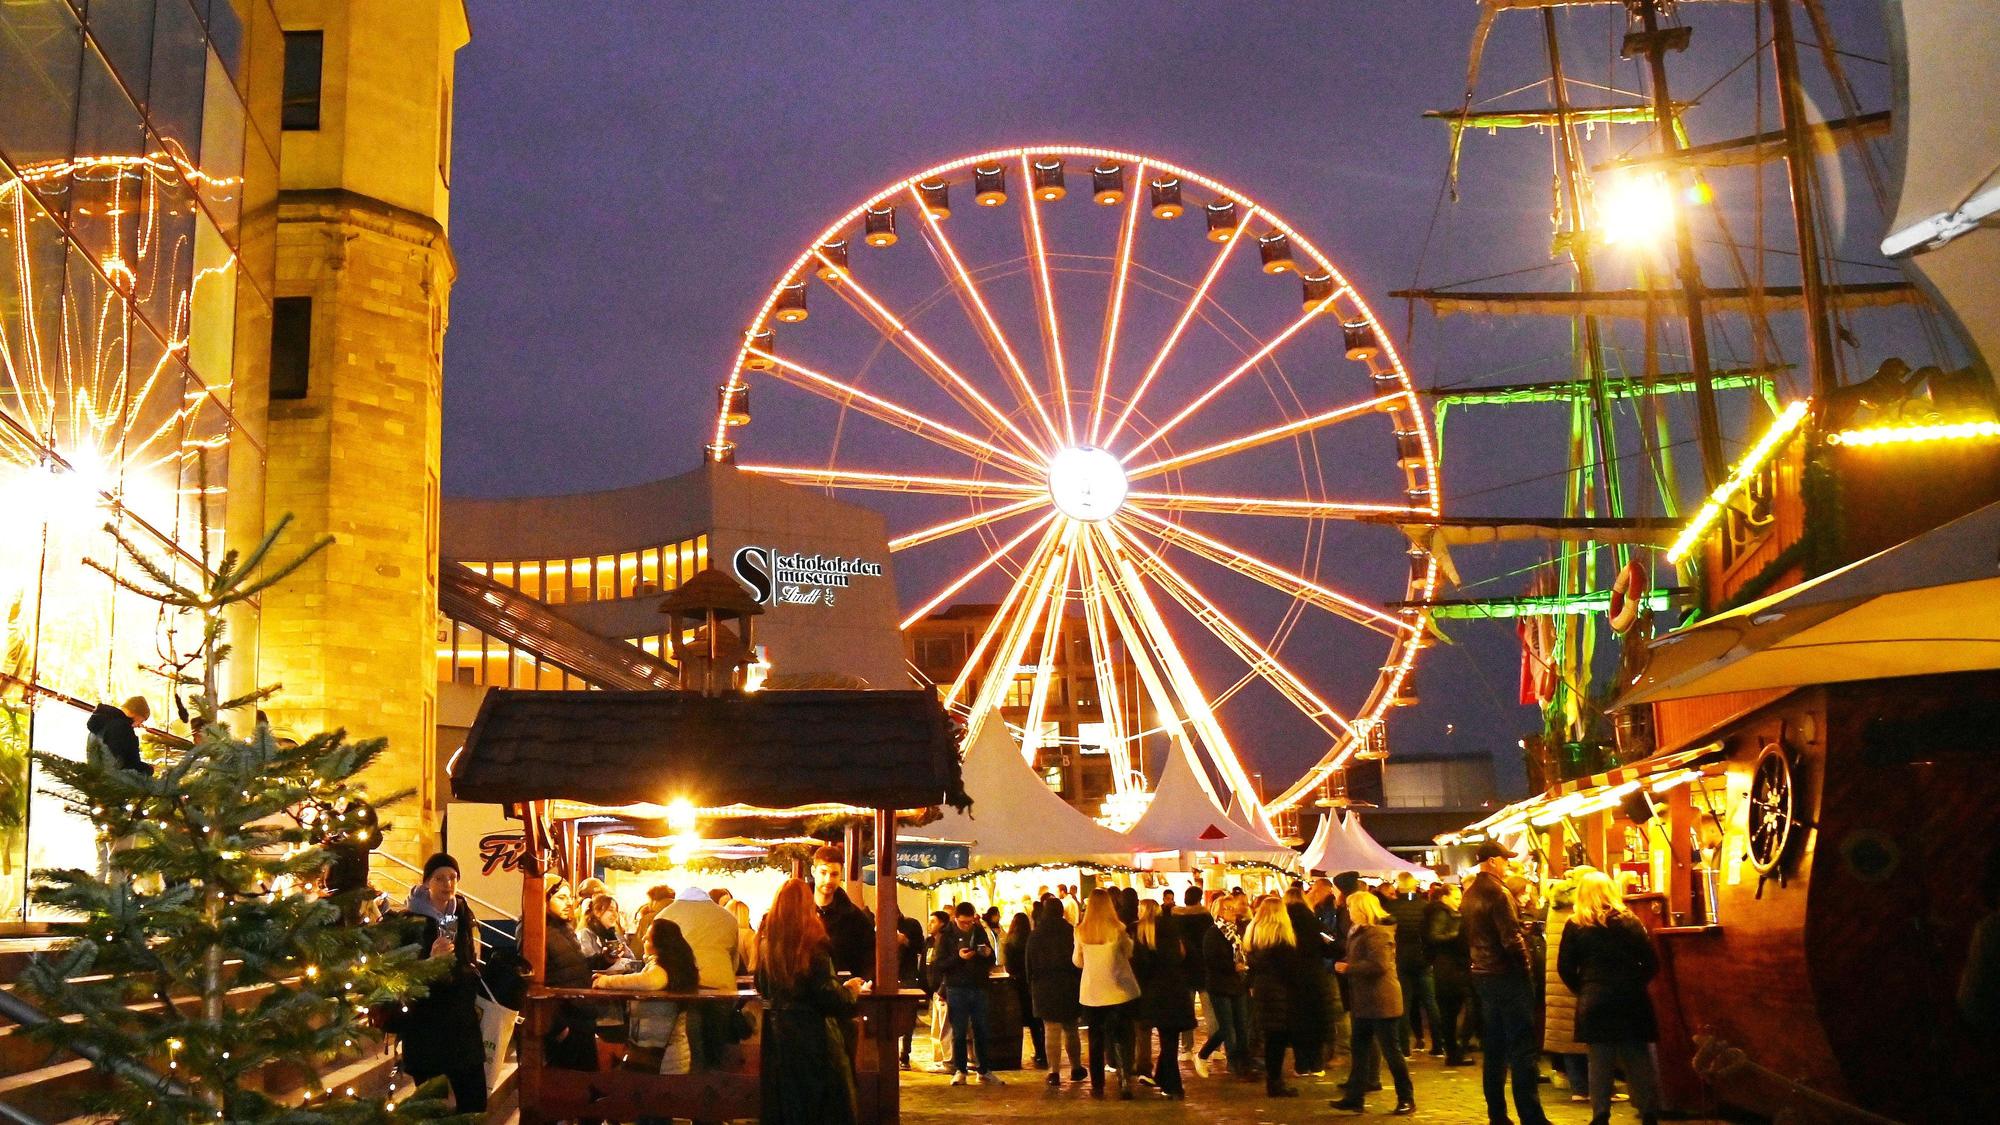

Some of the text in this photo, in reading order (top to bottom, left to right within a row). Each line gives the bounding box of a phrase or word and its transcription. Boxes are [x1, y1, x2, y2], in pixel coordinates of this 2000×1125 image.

[777, 553, 881, 576] schokoladen
[777, 569, 848, 587] museum
[779, 586, 821, 604] Lindt
